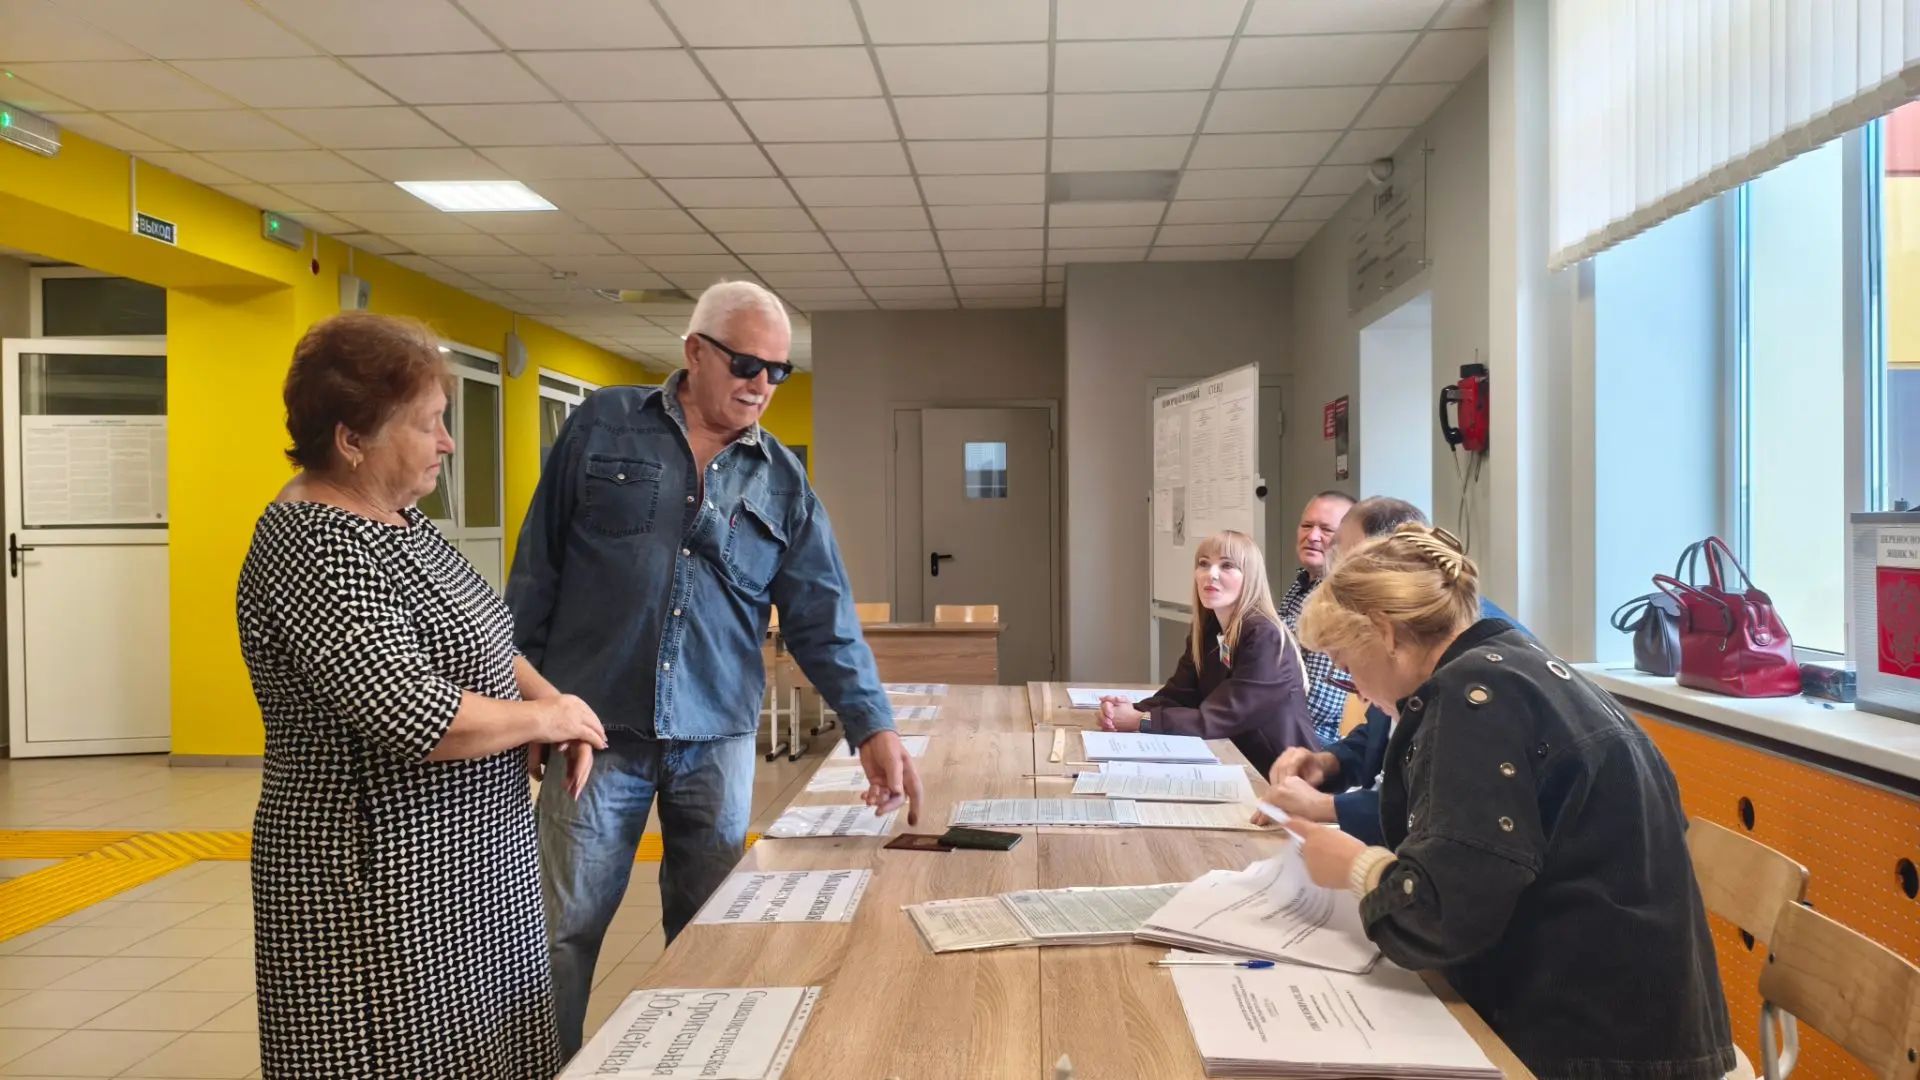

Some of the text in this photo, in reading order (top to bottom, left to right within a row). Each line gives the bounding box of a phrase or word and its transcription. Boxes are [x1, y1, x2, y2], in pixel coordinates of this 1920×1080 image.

[140, 217, 171, 240] ВЫХОД
[1880, 535, 1920, 544] ПЕРЕНОСНО
[595, 992, 684, 1075] Юбилейная
[652, 992, 730, 1076] Строительная
[700, 990, 767, 1077] Социалистическая
